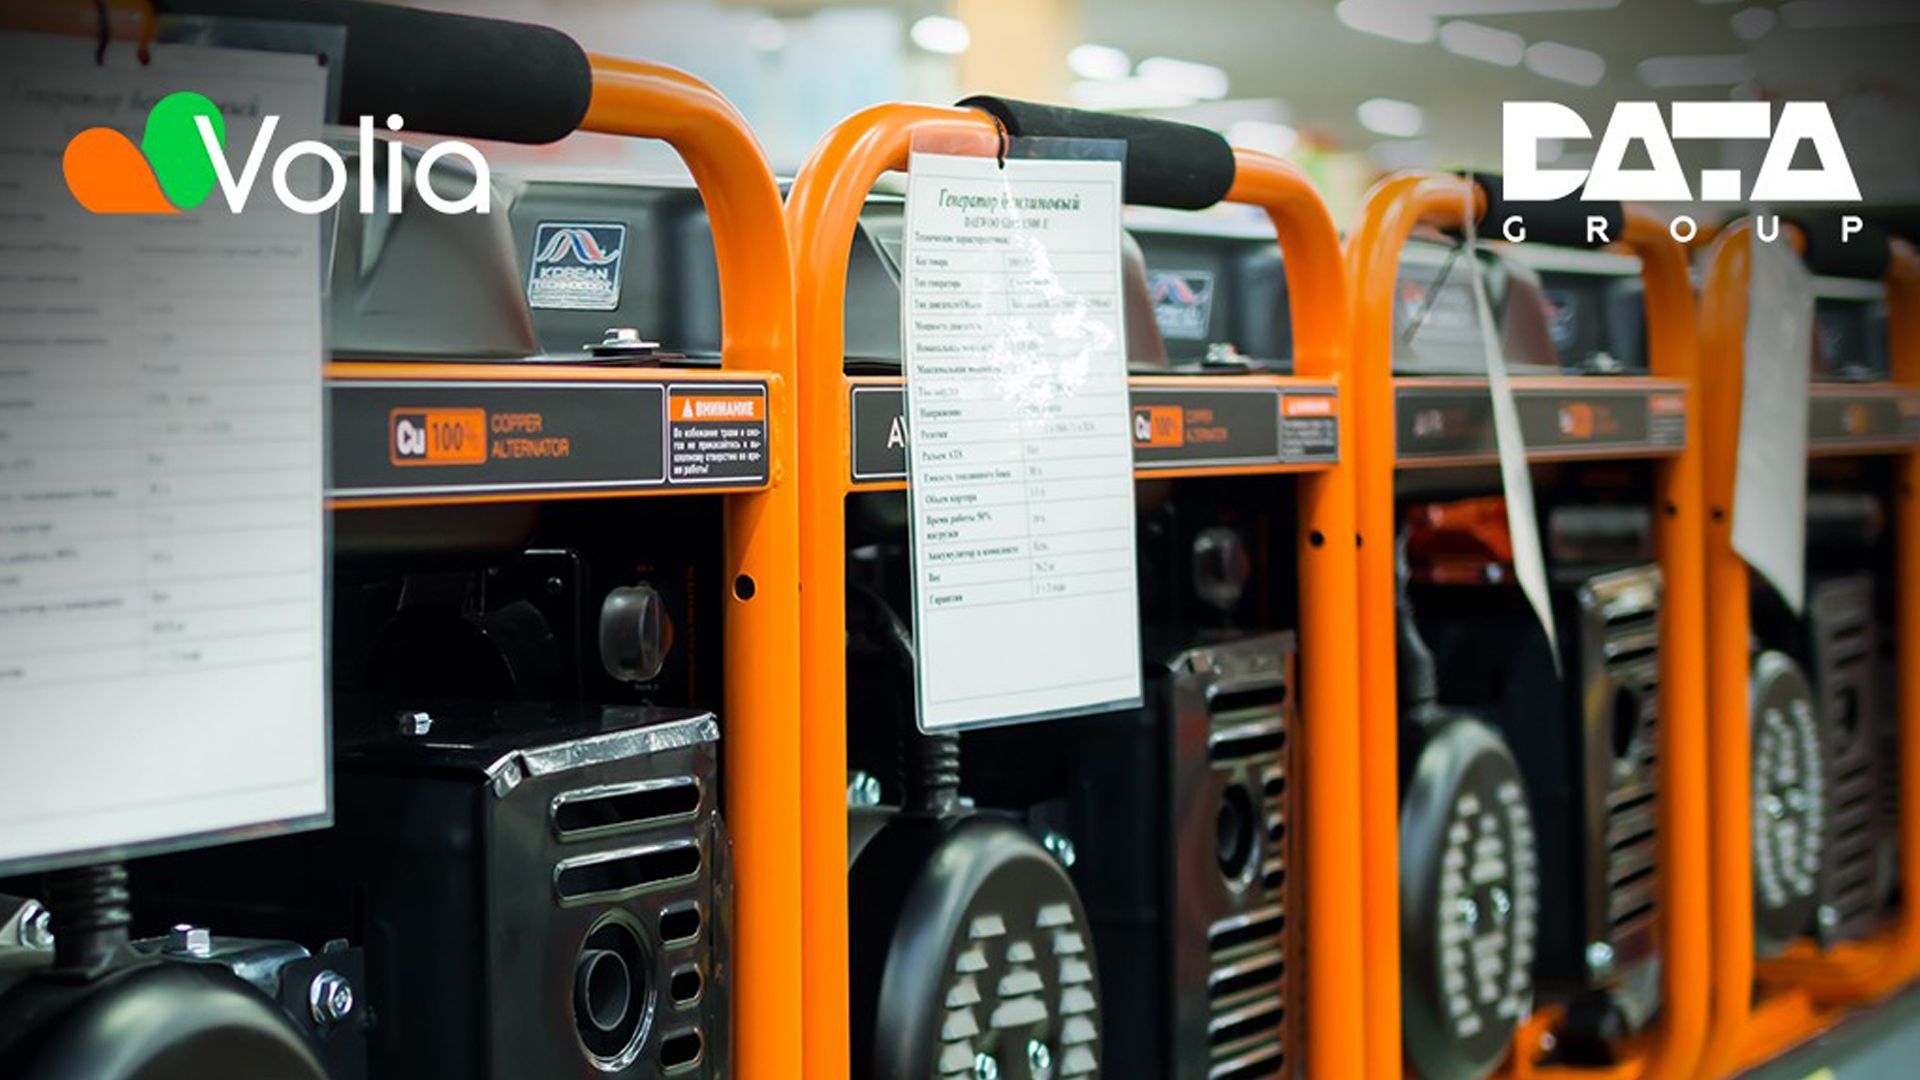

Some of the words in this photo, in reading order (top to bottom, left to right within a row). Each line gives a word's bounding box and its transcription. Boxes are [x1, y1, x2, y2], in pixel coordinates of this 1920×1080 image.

[939, 188, 997, 213] Генератор
[696, 401, 754, 417] ВНИМАНИЕ
[491, 413, 542, 433] COPPER
[397, 419, 425, 455] Cu
[492, 438, 569, 458] ALTERNATOR
